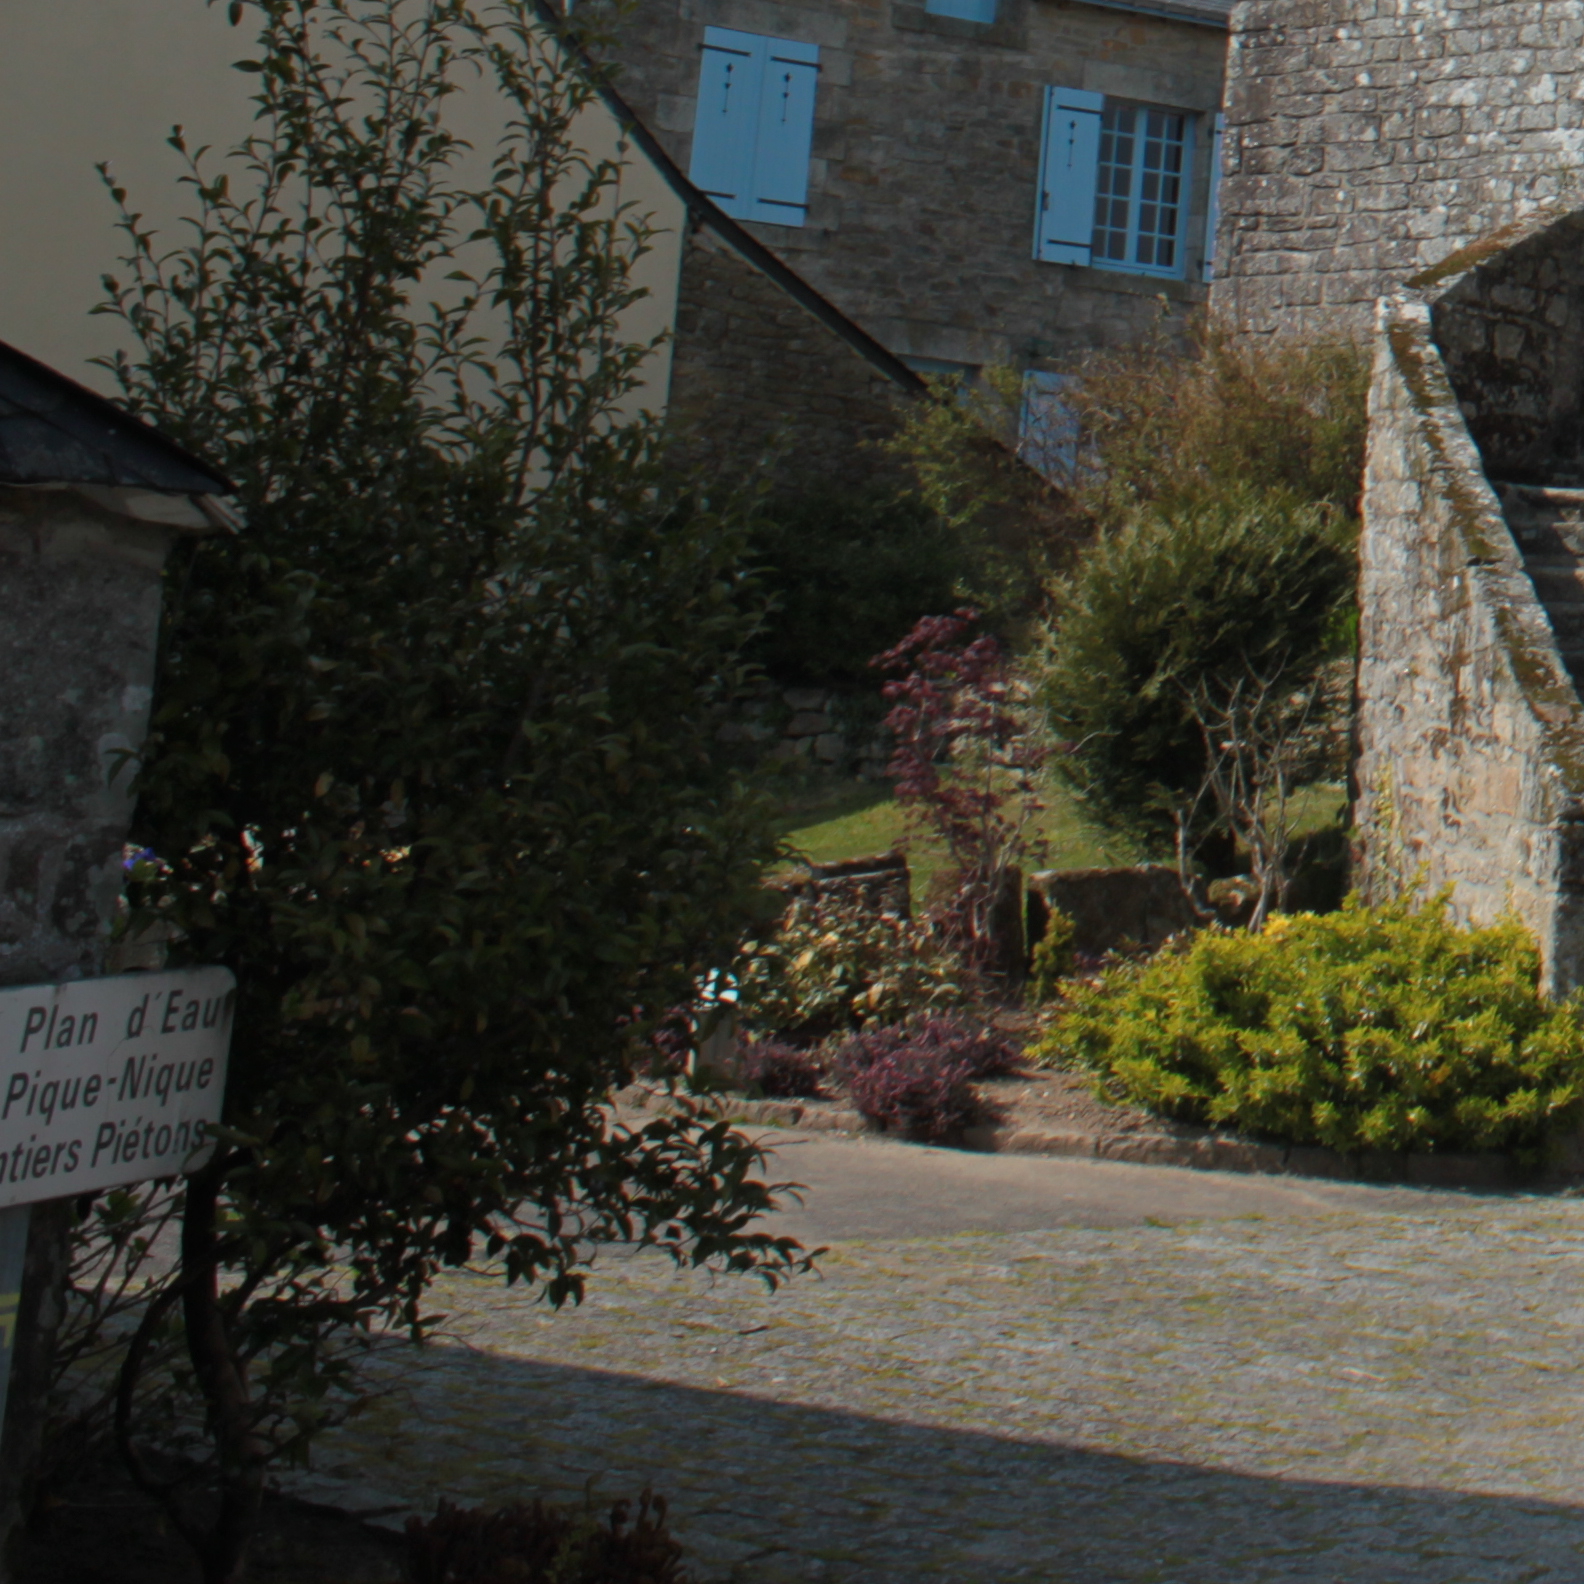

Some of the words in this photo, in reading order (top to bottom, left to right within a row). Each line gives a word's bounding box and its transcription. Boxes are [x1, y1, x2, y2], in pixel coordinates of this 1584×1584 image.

[20, 1005, 98, 1053] Plan
[1, 1054, 214, 1126] Pique-Nique
[90, 1115, 207, 1168] Piétons
